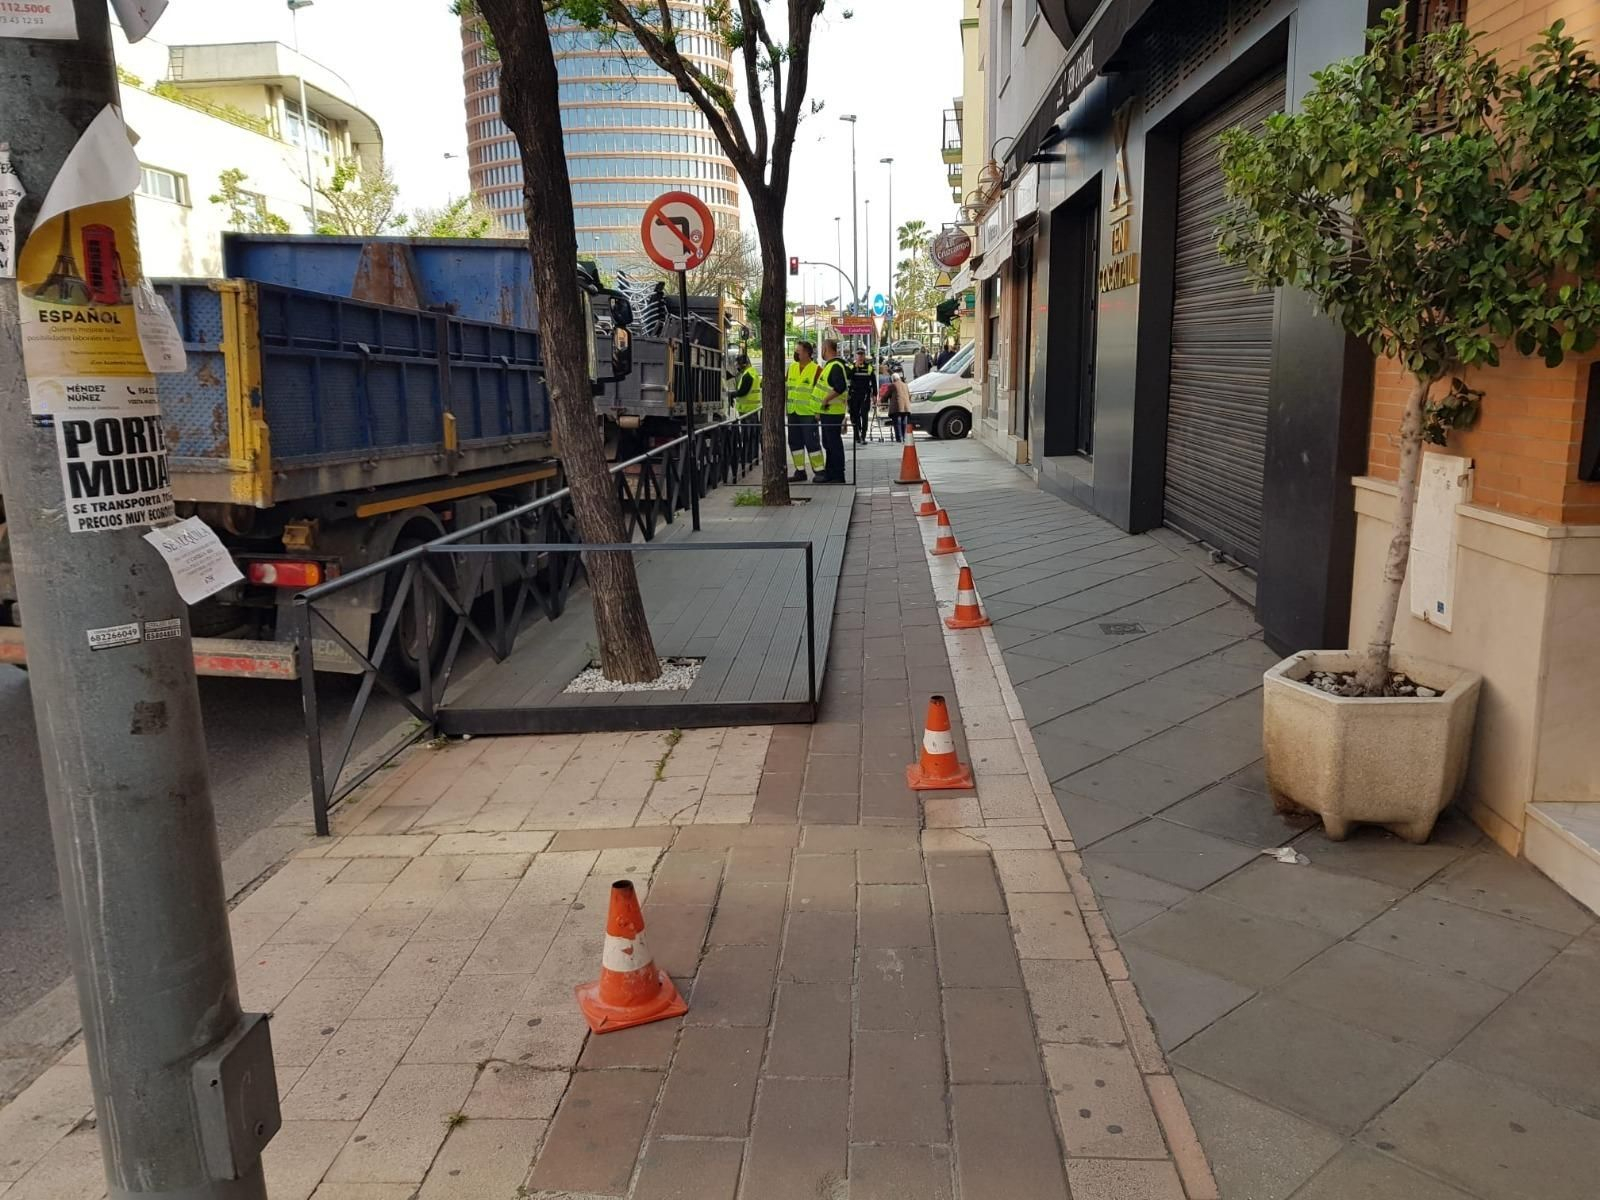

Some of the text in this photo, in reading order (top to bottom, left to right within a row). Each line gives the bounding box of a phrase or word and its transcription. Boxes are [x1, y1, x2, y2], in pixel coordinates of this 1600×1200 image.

[38, 308, 121, 325] ESPAÑOL
[66, 384, 106, 393] MÉNDEZ
[67, 393, 101, 402] NÚÑEZ
[73, 503, 87, 515] SE
[90, 494, 161, 514] TRANSPORTA
[78, 512, 123, 531] PRECIOS
[126, 509, 146, 525] MUY
